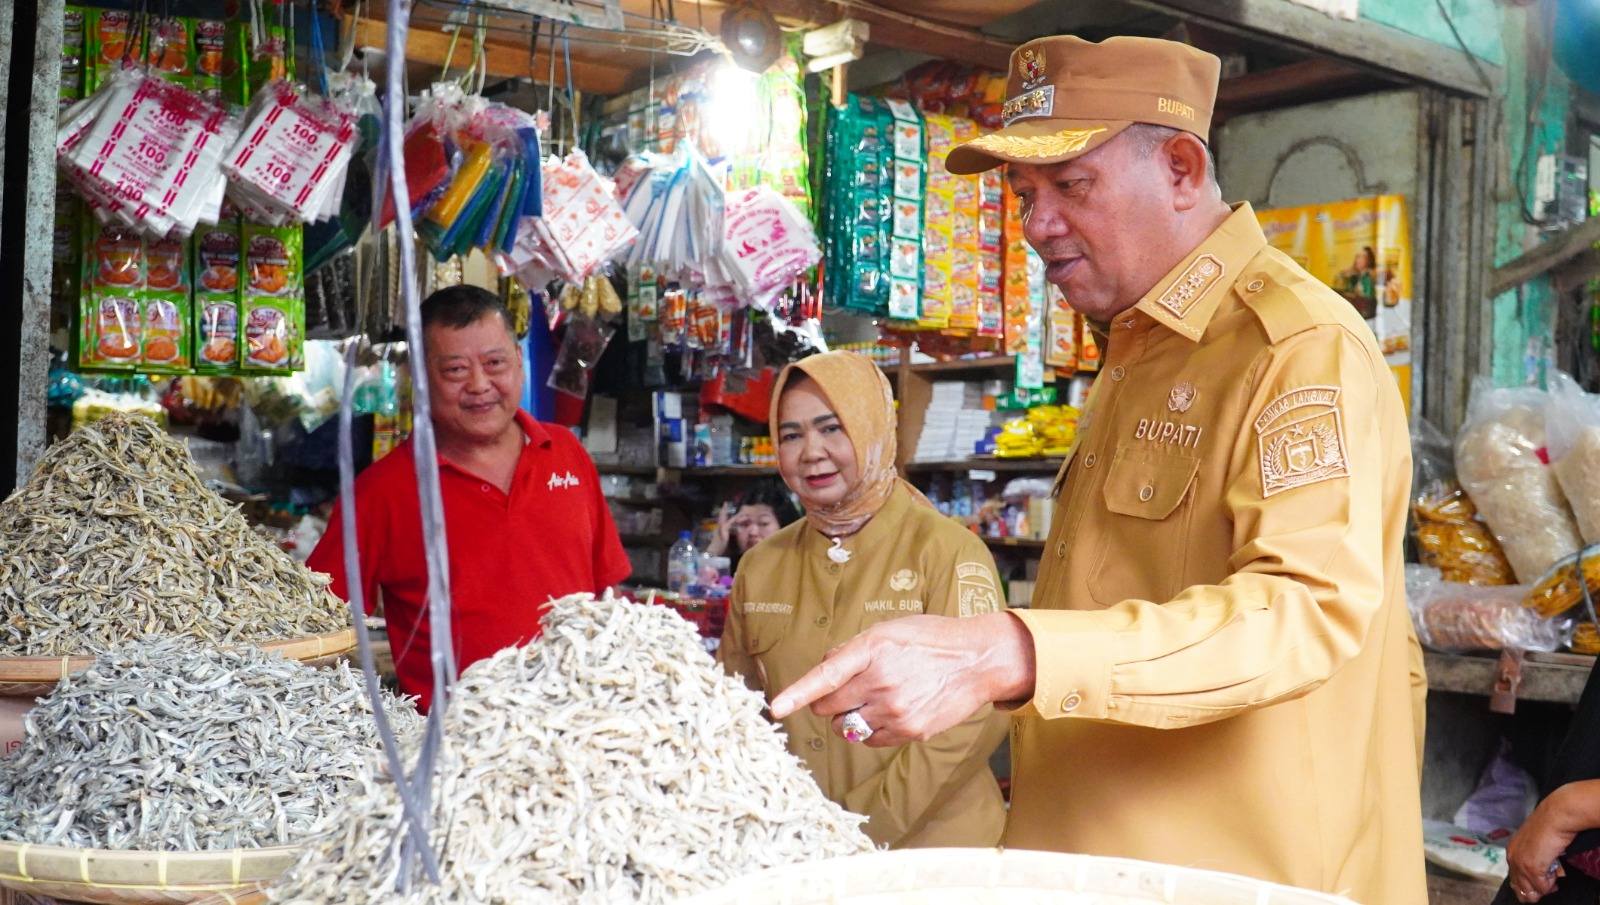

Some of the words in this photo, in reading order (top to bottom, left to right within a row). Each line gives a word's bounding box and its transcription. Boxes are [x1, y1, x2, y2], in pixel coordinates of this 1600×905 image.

[1157, 97, 1195, 121] BUPATI
[293, 124, 318, 145] 100
[139, 142, 165, 163] 100
[266, 162, 292, 184] 100
[114, 180, 143, 201] 100
[1135, 418, 1203, 449] BUPATI
[864, 599, 896, 614] WAKIL
